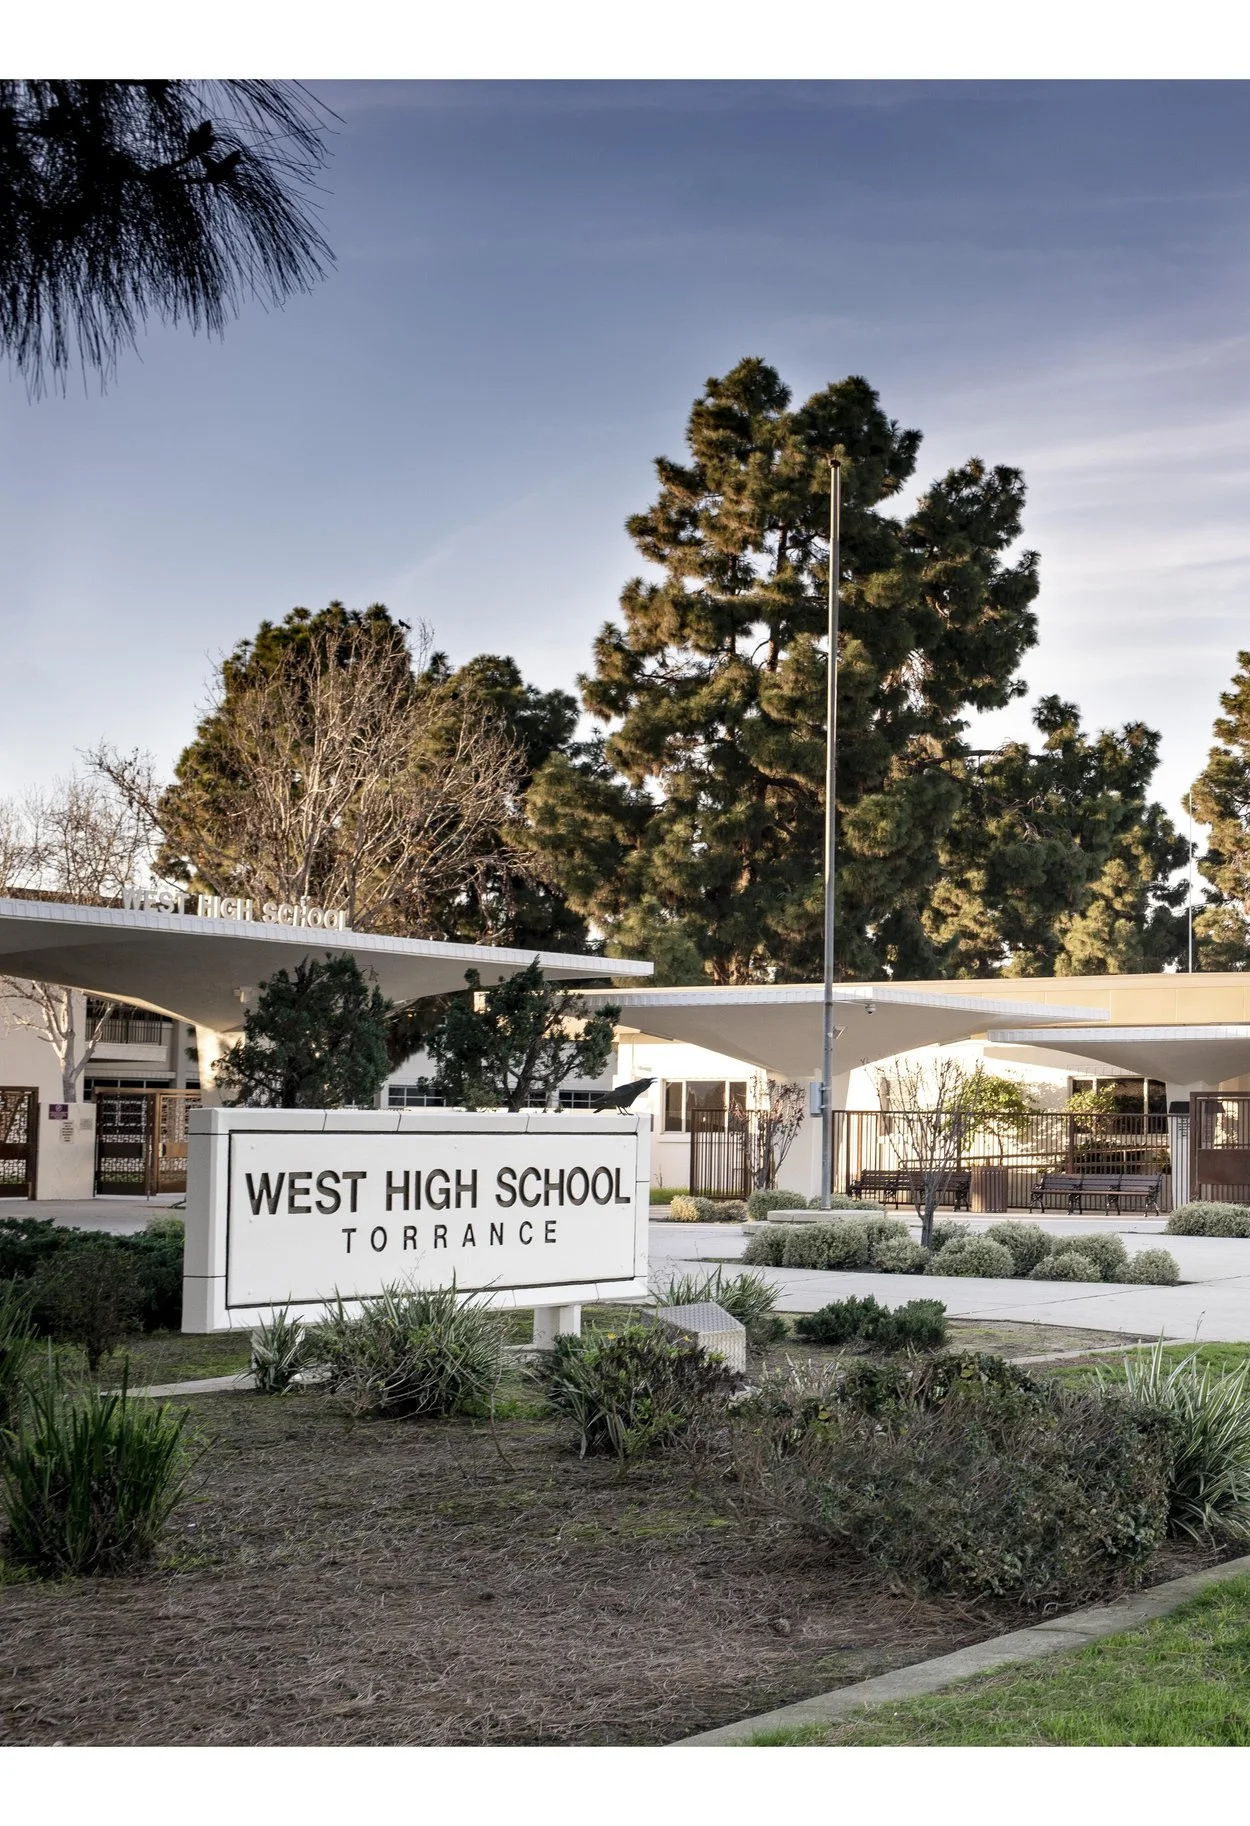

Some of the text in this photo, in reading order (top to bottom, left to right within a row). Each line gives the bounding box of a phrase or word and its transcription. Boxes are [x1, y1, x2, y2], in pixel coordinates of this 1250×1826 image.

[122, 886, 352, 932] WEST HIGH SCHOOL
[245, 1166, 630, 1215] WEST HIGH SCHOOL
[342, 1221, 556, 1253] TORRANCE
